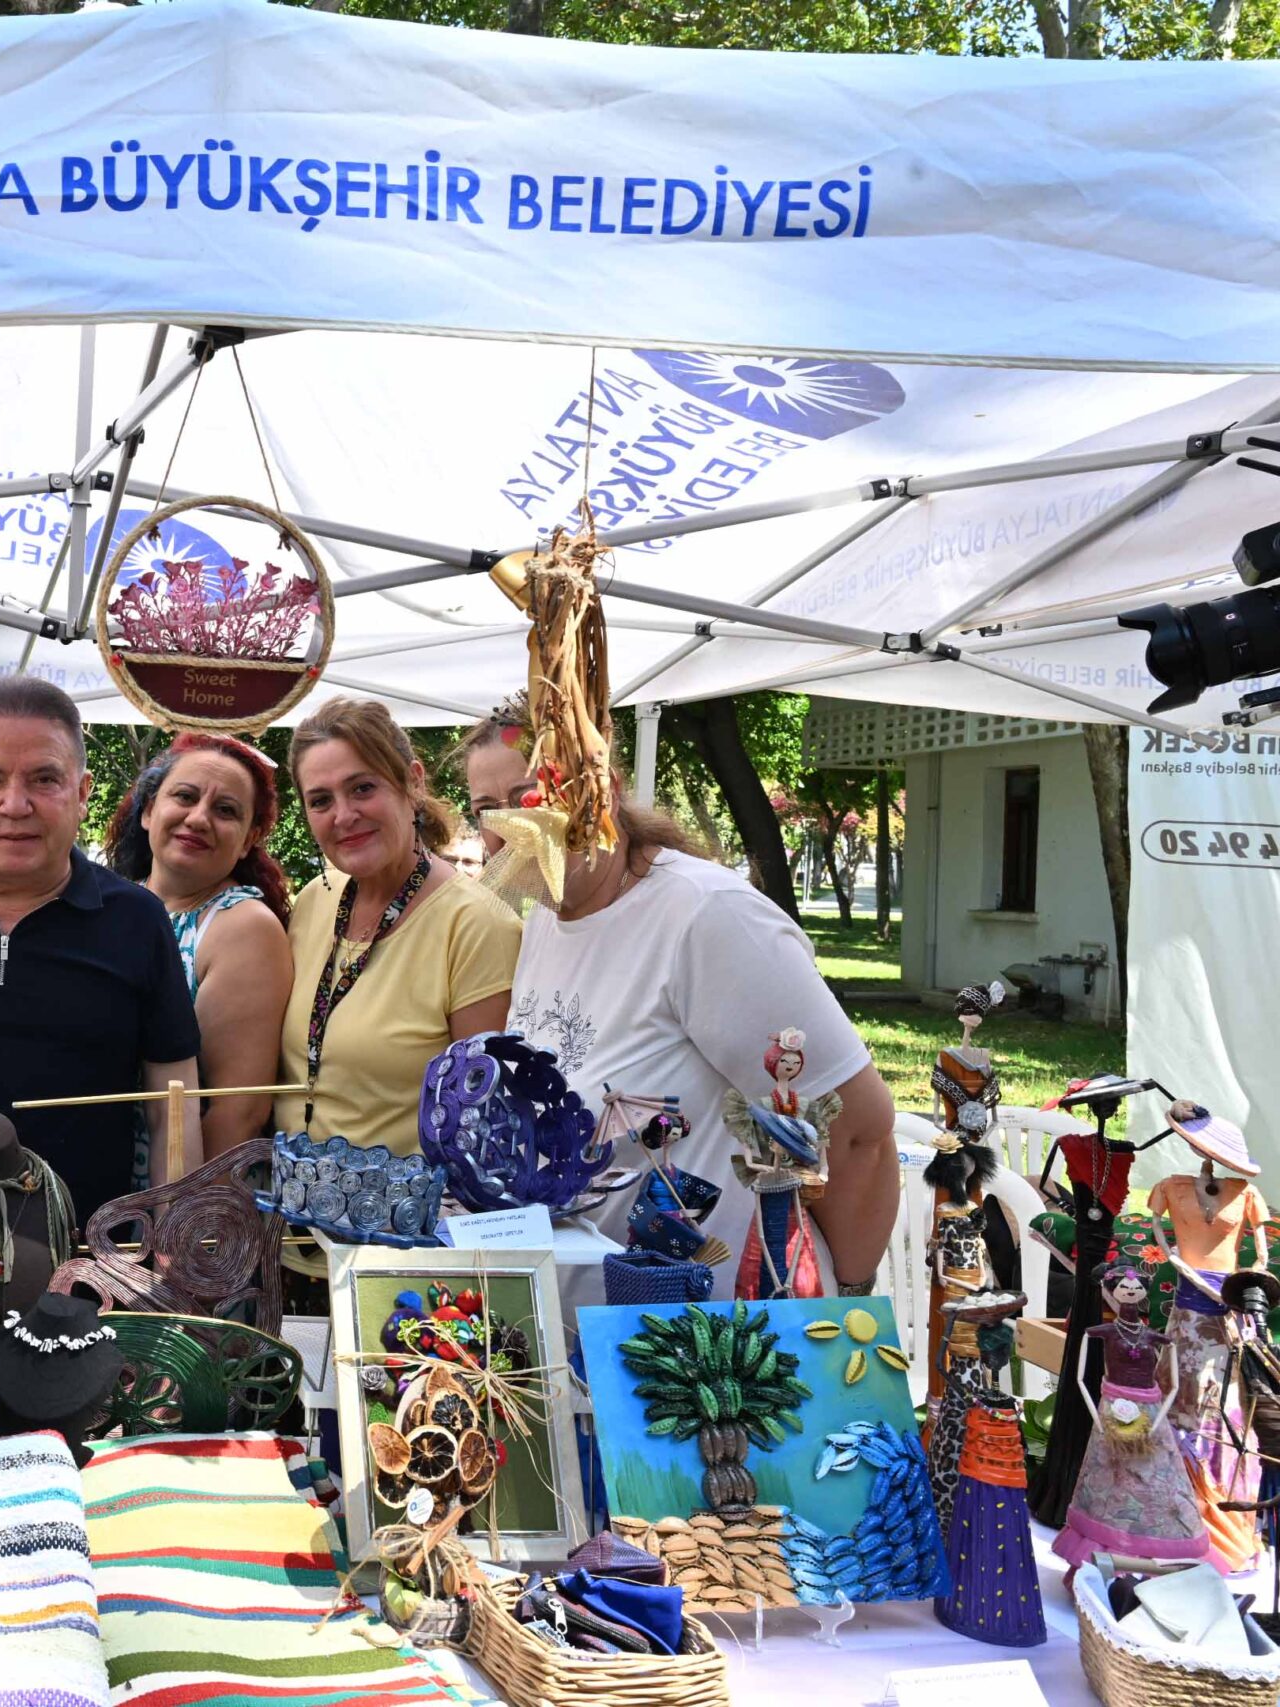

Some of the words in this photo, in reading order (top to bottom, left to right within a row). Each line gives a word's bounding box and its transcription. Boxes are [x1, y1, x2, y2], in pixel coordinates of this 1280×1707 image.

[61, 139, 482, 232] BÜYÜKŞEHİR
[509, 165, 871, 238] BELEDİYESİ
[184, 668, 237, 687] Sweet
[183, 688, 236, 706] Home
